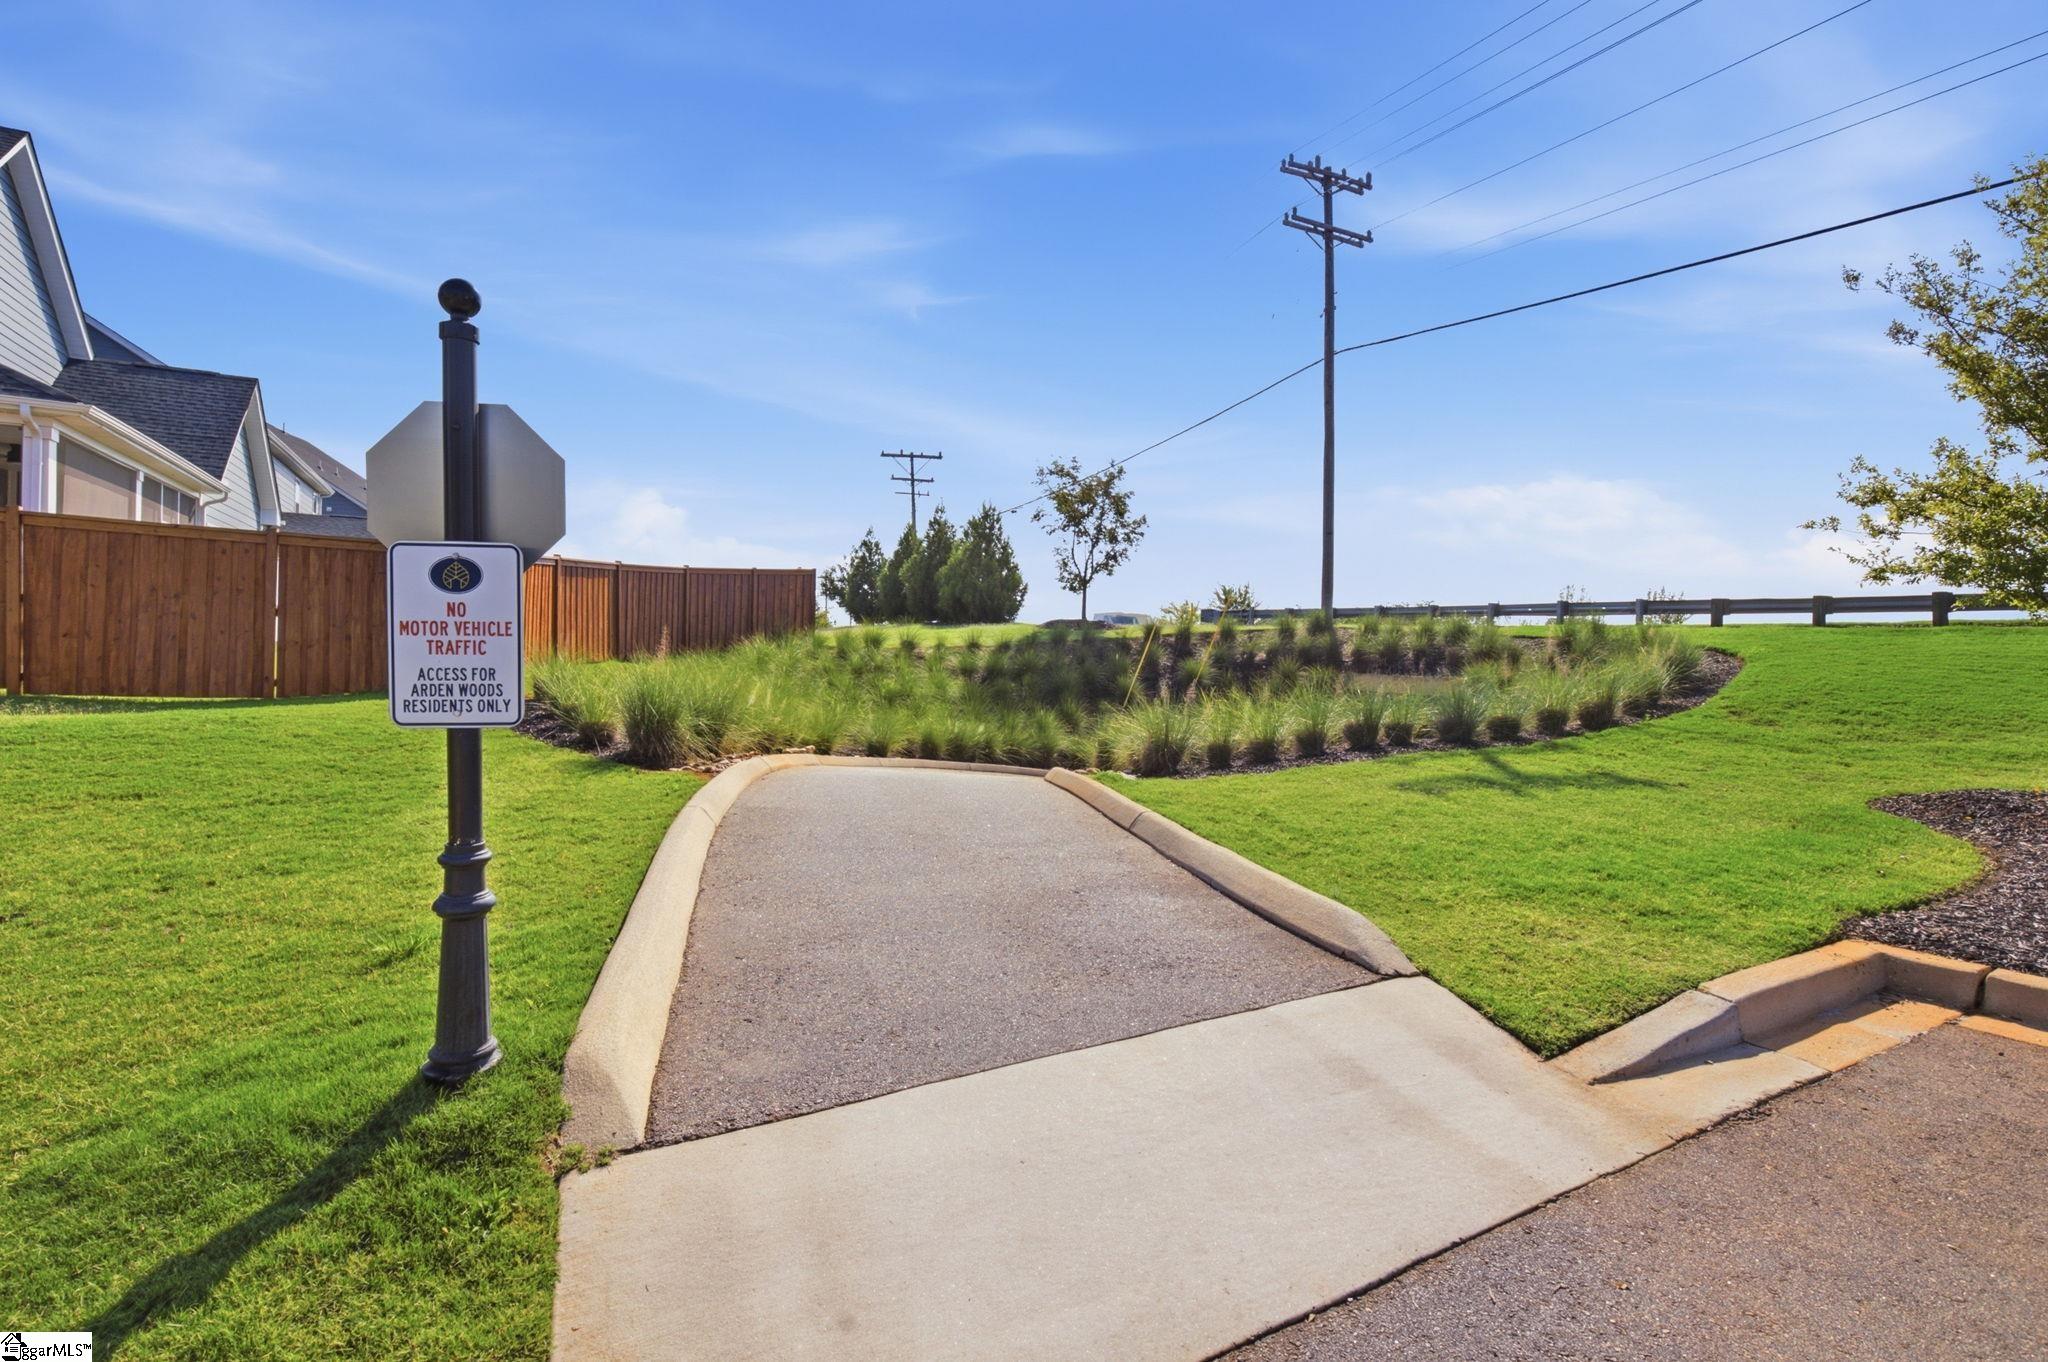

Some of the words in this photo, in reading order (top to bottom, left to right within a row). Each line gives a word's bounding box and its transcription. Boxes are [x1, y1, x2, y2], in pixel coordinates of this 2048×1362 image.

[447, 602, 466, 617] NO
[400, 621, 448, 636] MOTOR
[455, 621, 512, 637] VEHICLE
[426, 640, 487, 655] TRAFFIC
[417, 667, 467, 681] ACCESS
[472, 667, 496, 681] FOR
[411, 683, 455, 697] ARDEN
[458, 683, 503, 697] WOODS
[403, 699, 473, 713] RESIDENTS
[478, 699, 511, 713] ONLY
